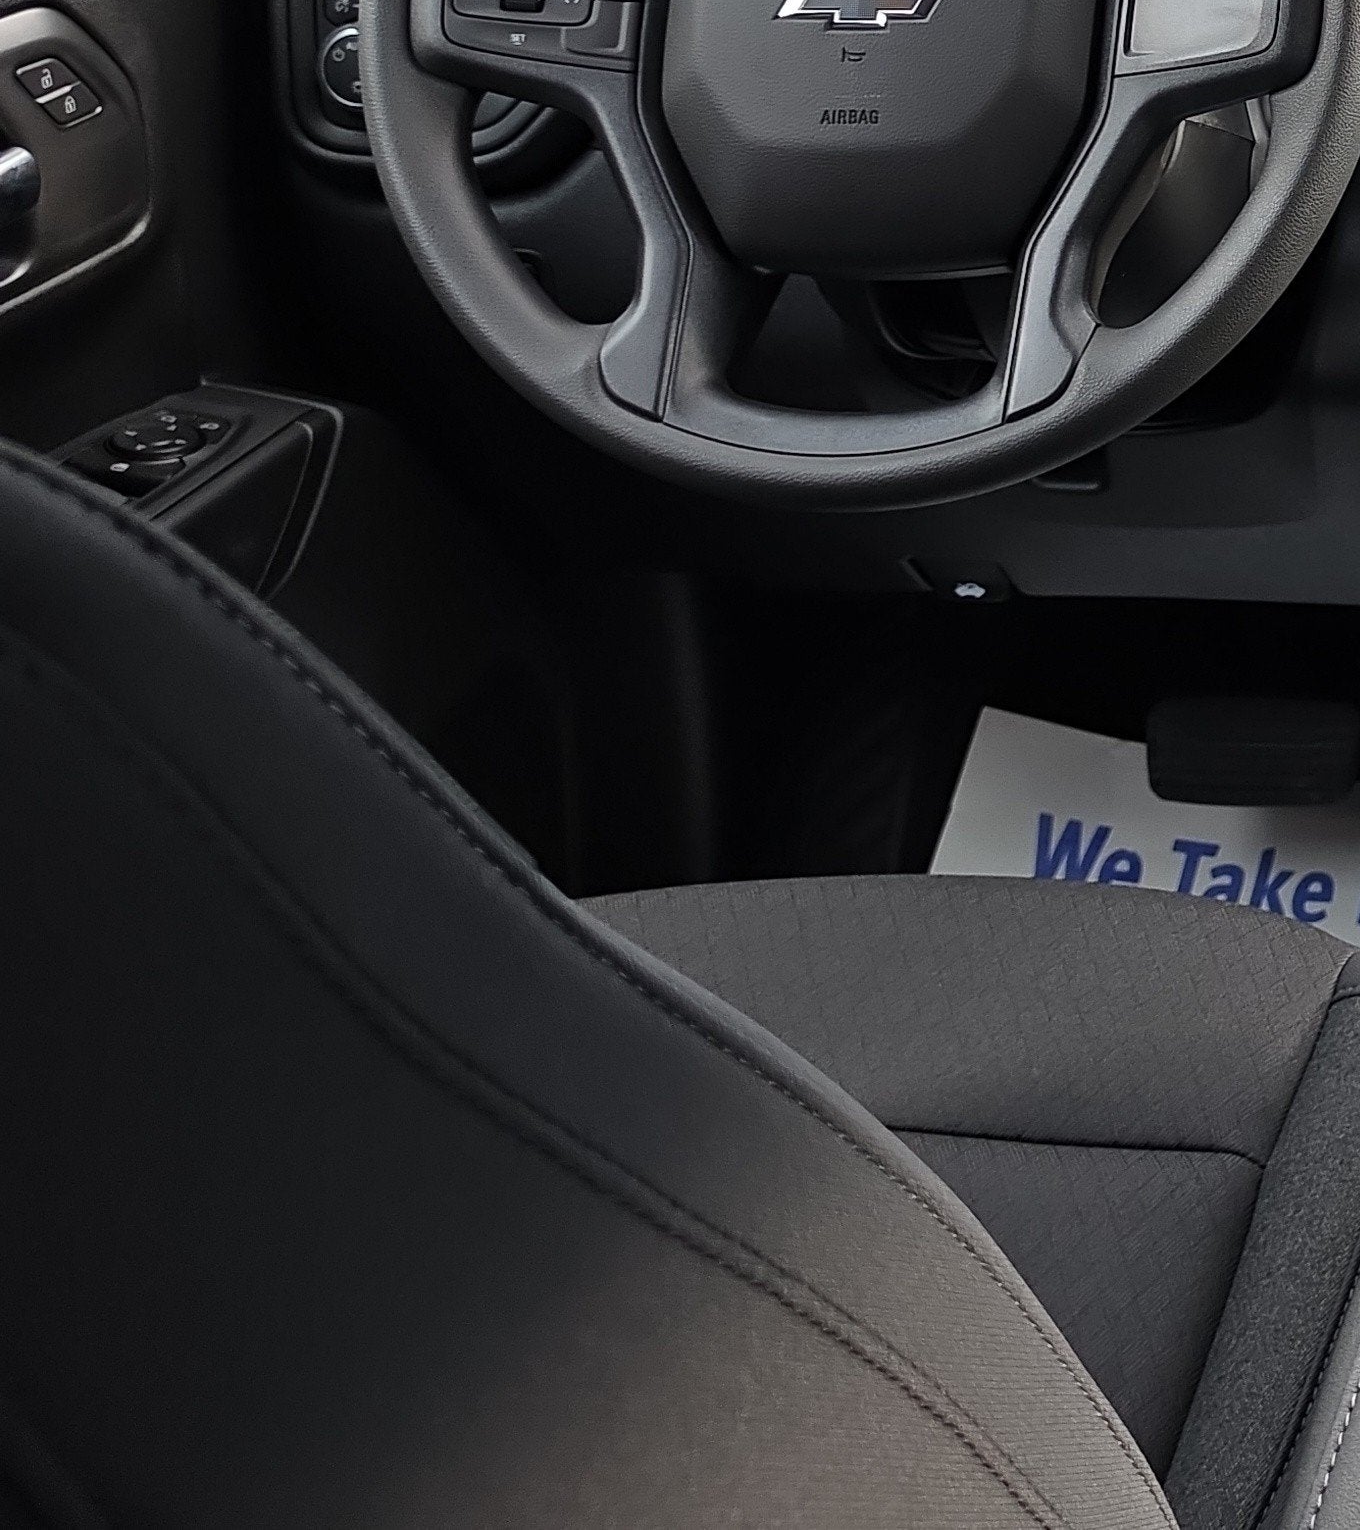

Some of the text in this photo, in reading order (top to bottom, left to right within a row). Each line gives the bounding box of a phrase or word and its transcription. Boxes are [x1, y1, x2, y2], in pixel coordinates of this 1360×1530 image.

[819, 109, 880, 126] AIRBAG
[1033, 812, 1143, 886] We
[1171, 838, 1336, 923] Take
